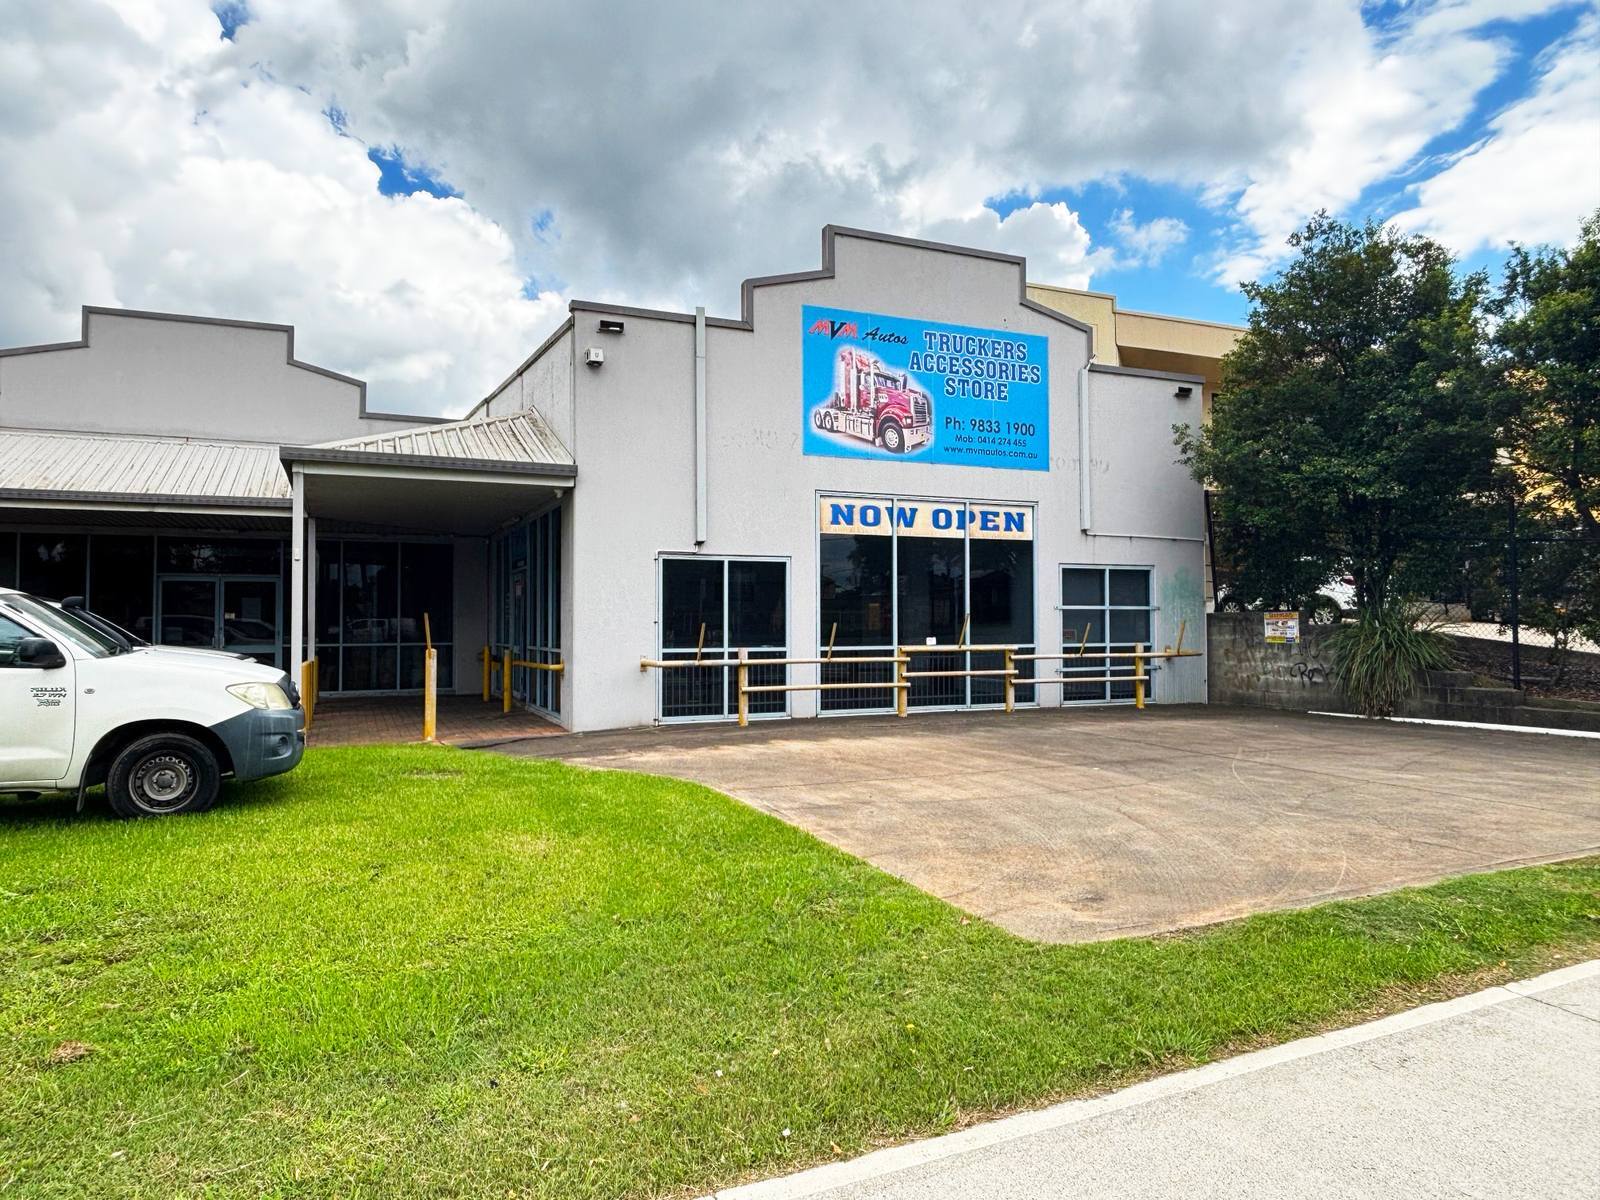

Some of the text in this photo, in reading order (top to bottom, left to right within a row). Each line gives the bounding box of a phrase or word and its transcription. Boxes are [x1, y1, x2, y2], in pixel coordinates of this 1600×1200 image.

[808, 319, 909, 344] MVM Autos
[924, 331, 1028, 361] TRUCKERS
[909, 352, 1041, 384] ACCESSORIES
[943, 376, 1009, 402] STORE
[945, 416, 1036, 437] Ph: 9833 1900
[944, 446, 1038, 460] www.mvmautos.com.au
[955, 434, 976, 443] Mob:
[977, 436, 997, 445] 0414
[998, 438, 1012, 447] 274
[830, 504, 1025, 532] NOW OPEN
